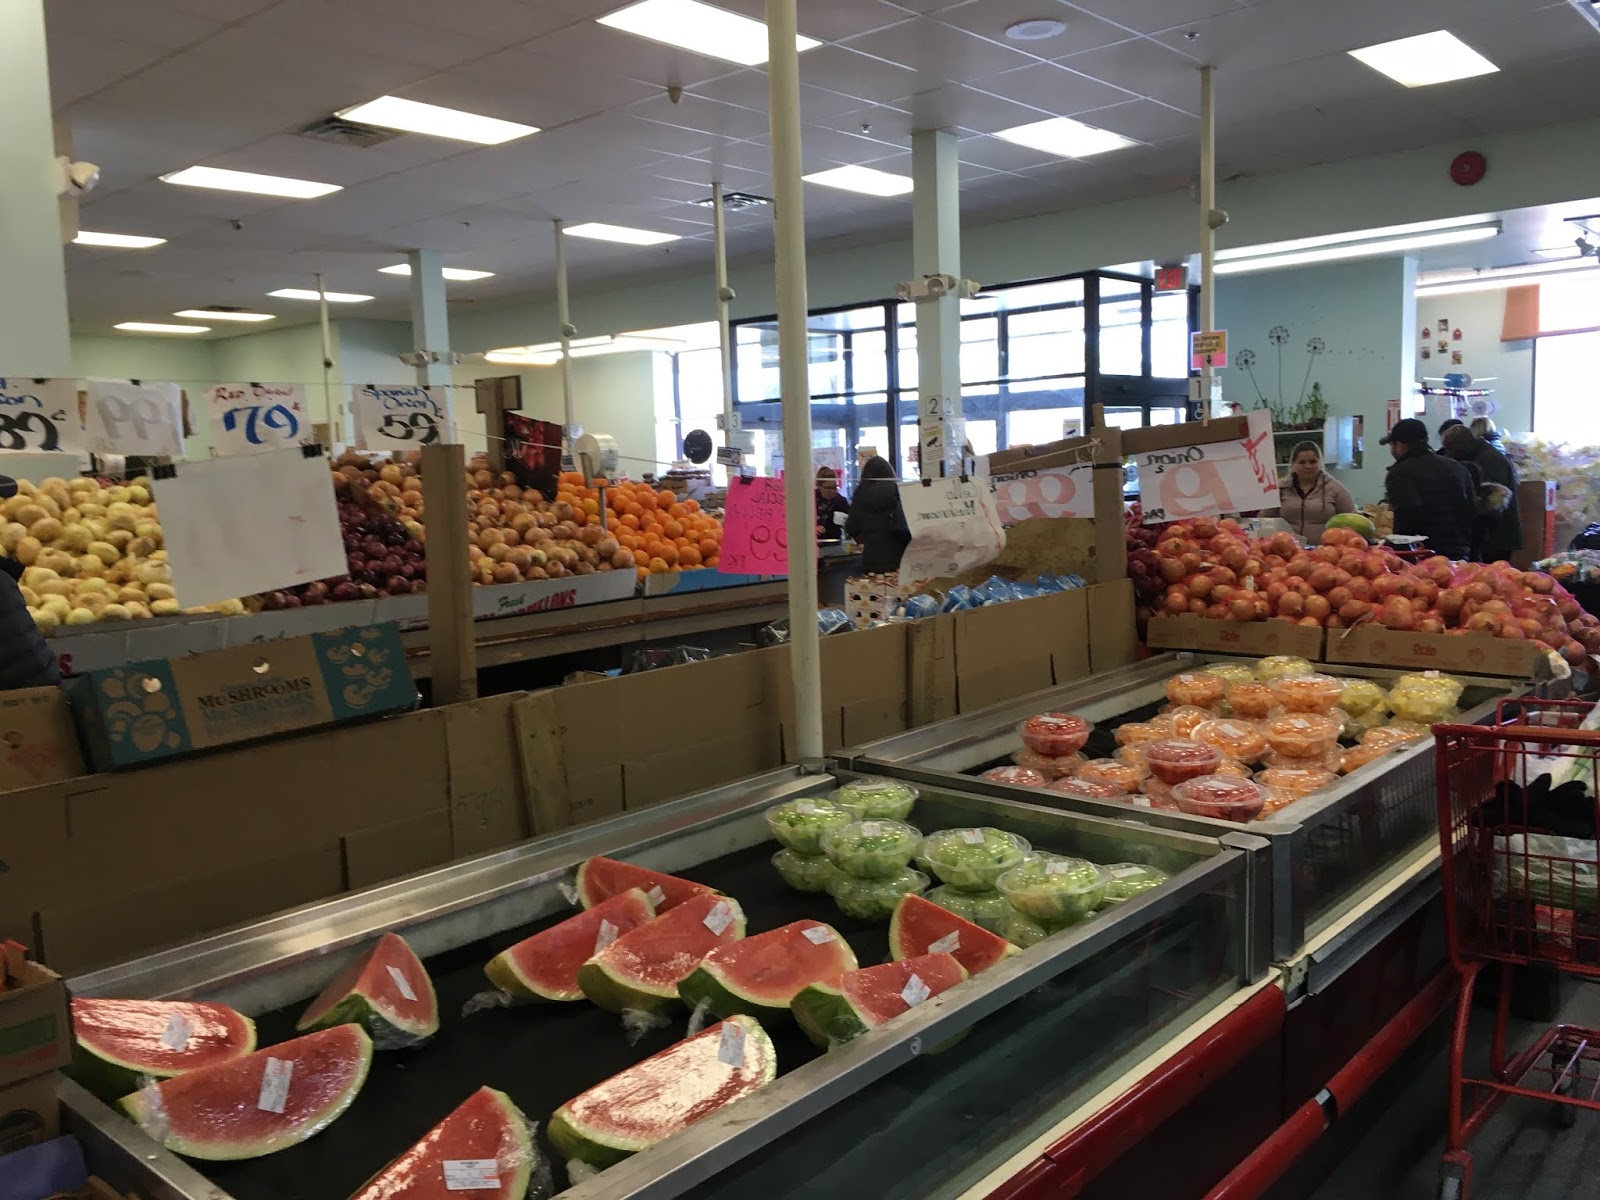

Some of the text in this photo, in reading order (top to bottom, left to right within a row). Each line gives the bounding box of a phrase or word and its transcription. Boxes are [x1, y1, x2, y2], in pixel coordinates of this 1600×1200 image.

[929, 398, 939, 414] 2
[223, 404, 299, 444] 79
[377, 412, 439, 444] 59
[197, 676, 311, 710] MUSHROOMS
